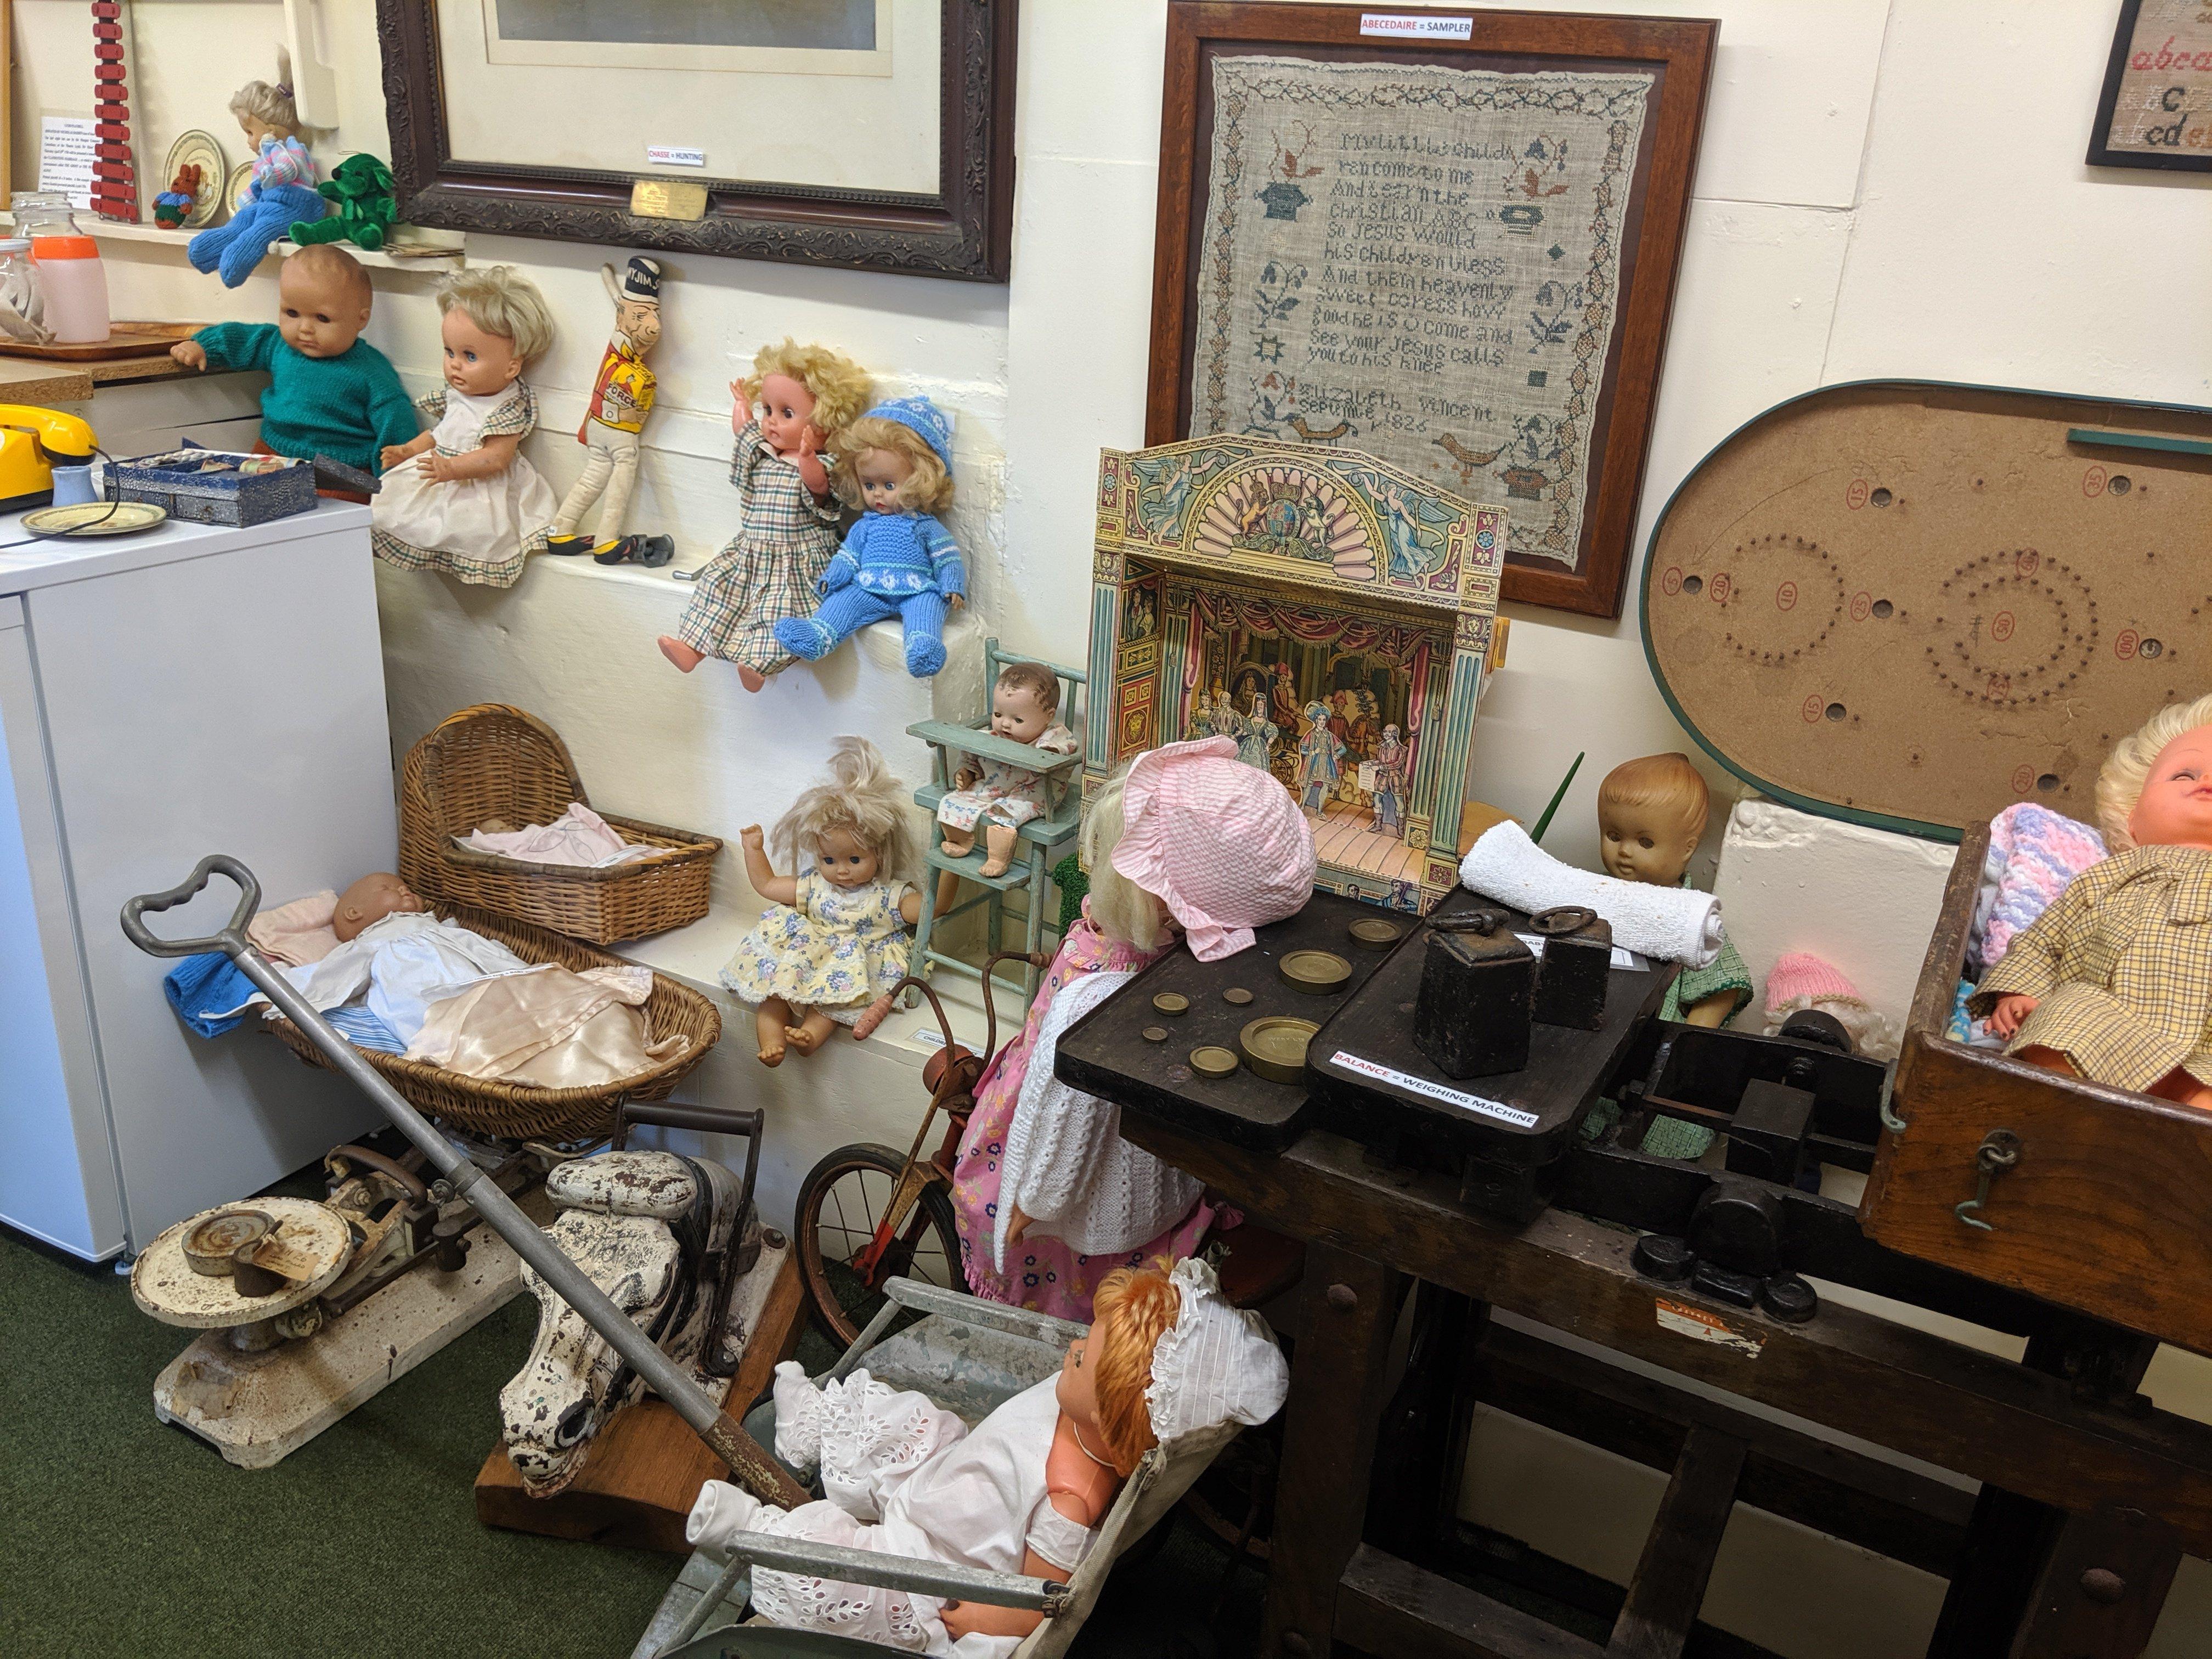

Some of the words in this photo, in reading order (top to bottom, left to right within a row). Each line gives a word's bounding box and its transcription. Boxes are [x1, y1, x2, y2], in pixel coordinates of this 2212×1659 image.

[1362, 19, 1417, 30] ABECEDAIRE
[1427, 22, 1470, 32] SAMPLER
[648, 150, 670, 159] CHASSE
[675, 152, 703, 161] HUNTING
[606, 382, 637, 408] FORCE
[1334, 1053, 1391, 1077] BALANCE
[1402, 1076, 1470, 1103] WEIGHING
[1471, 1099, 1537, 1124] MACHINE
